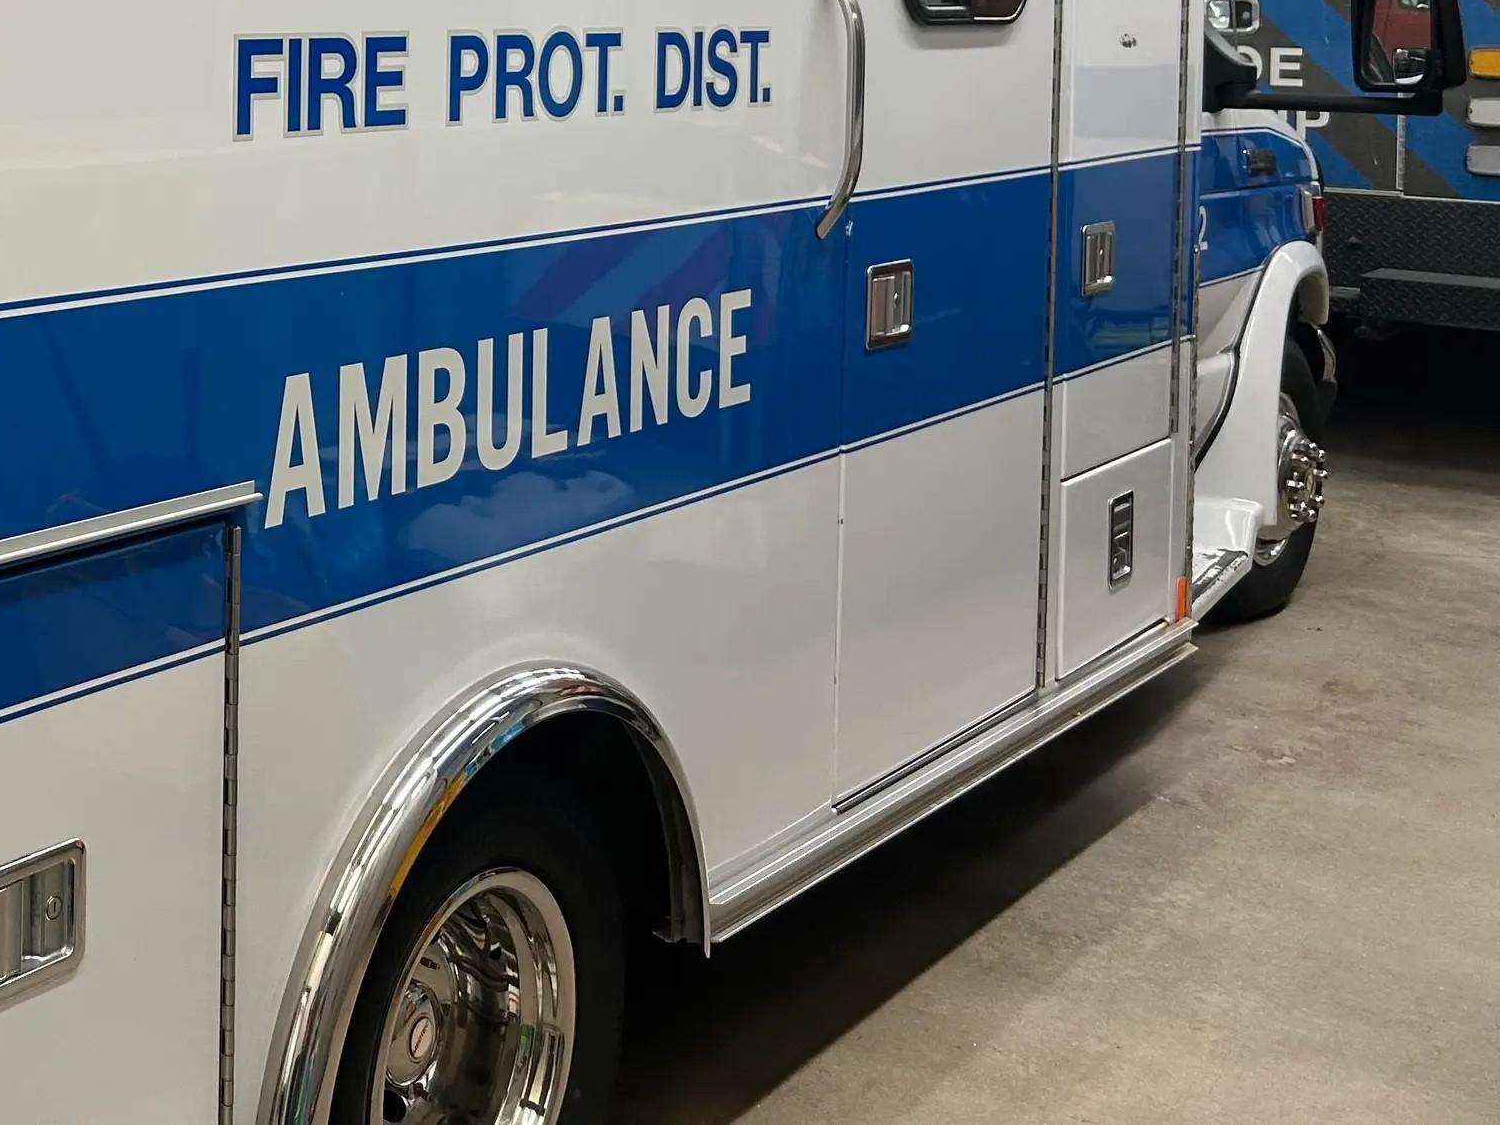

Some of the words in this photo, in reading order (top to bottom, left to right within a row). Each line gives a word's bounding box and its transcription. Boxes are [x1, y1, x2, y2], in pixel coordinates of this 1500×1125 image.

[234, 32, 409, 140] FIRE
[447, 27, 624, 126] PROT.
[654, 27, 772, 112] DIST.
[264, 288, 753, 530] AMBULANCE
